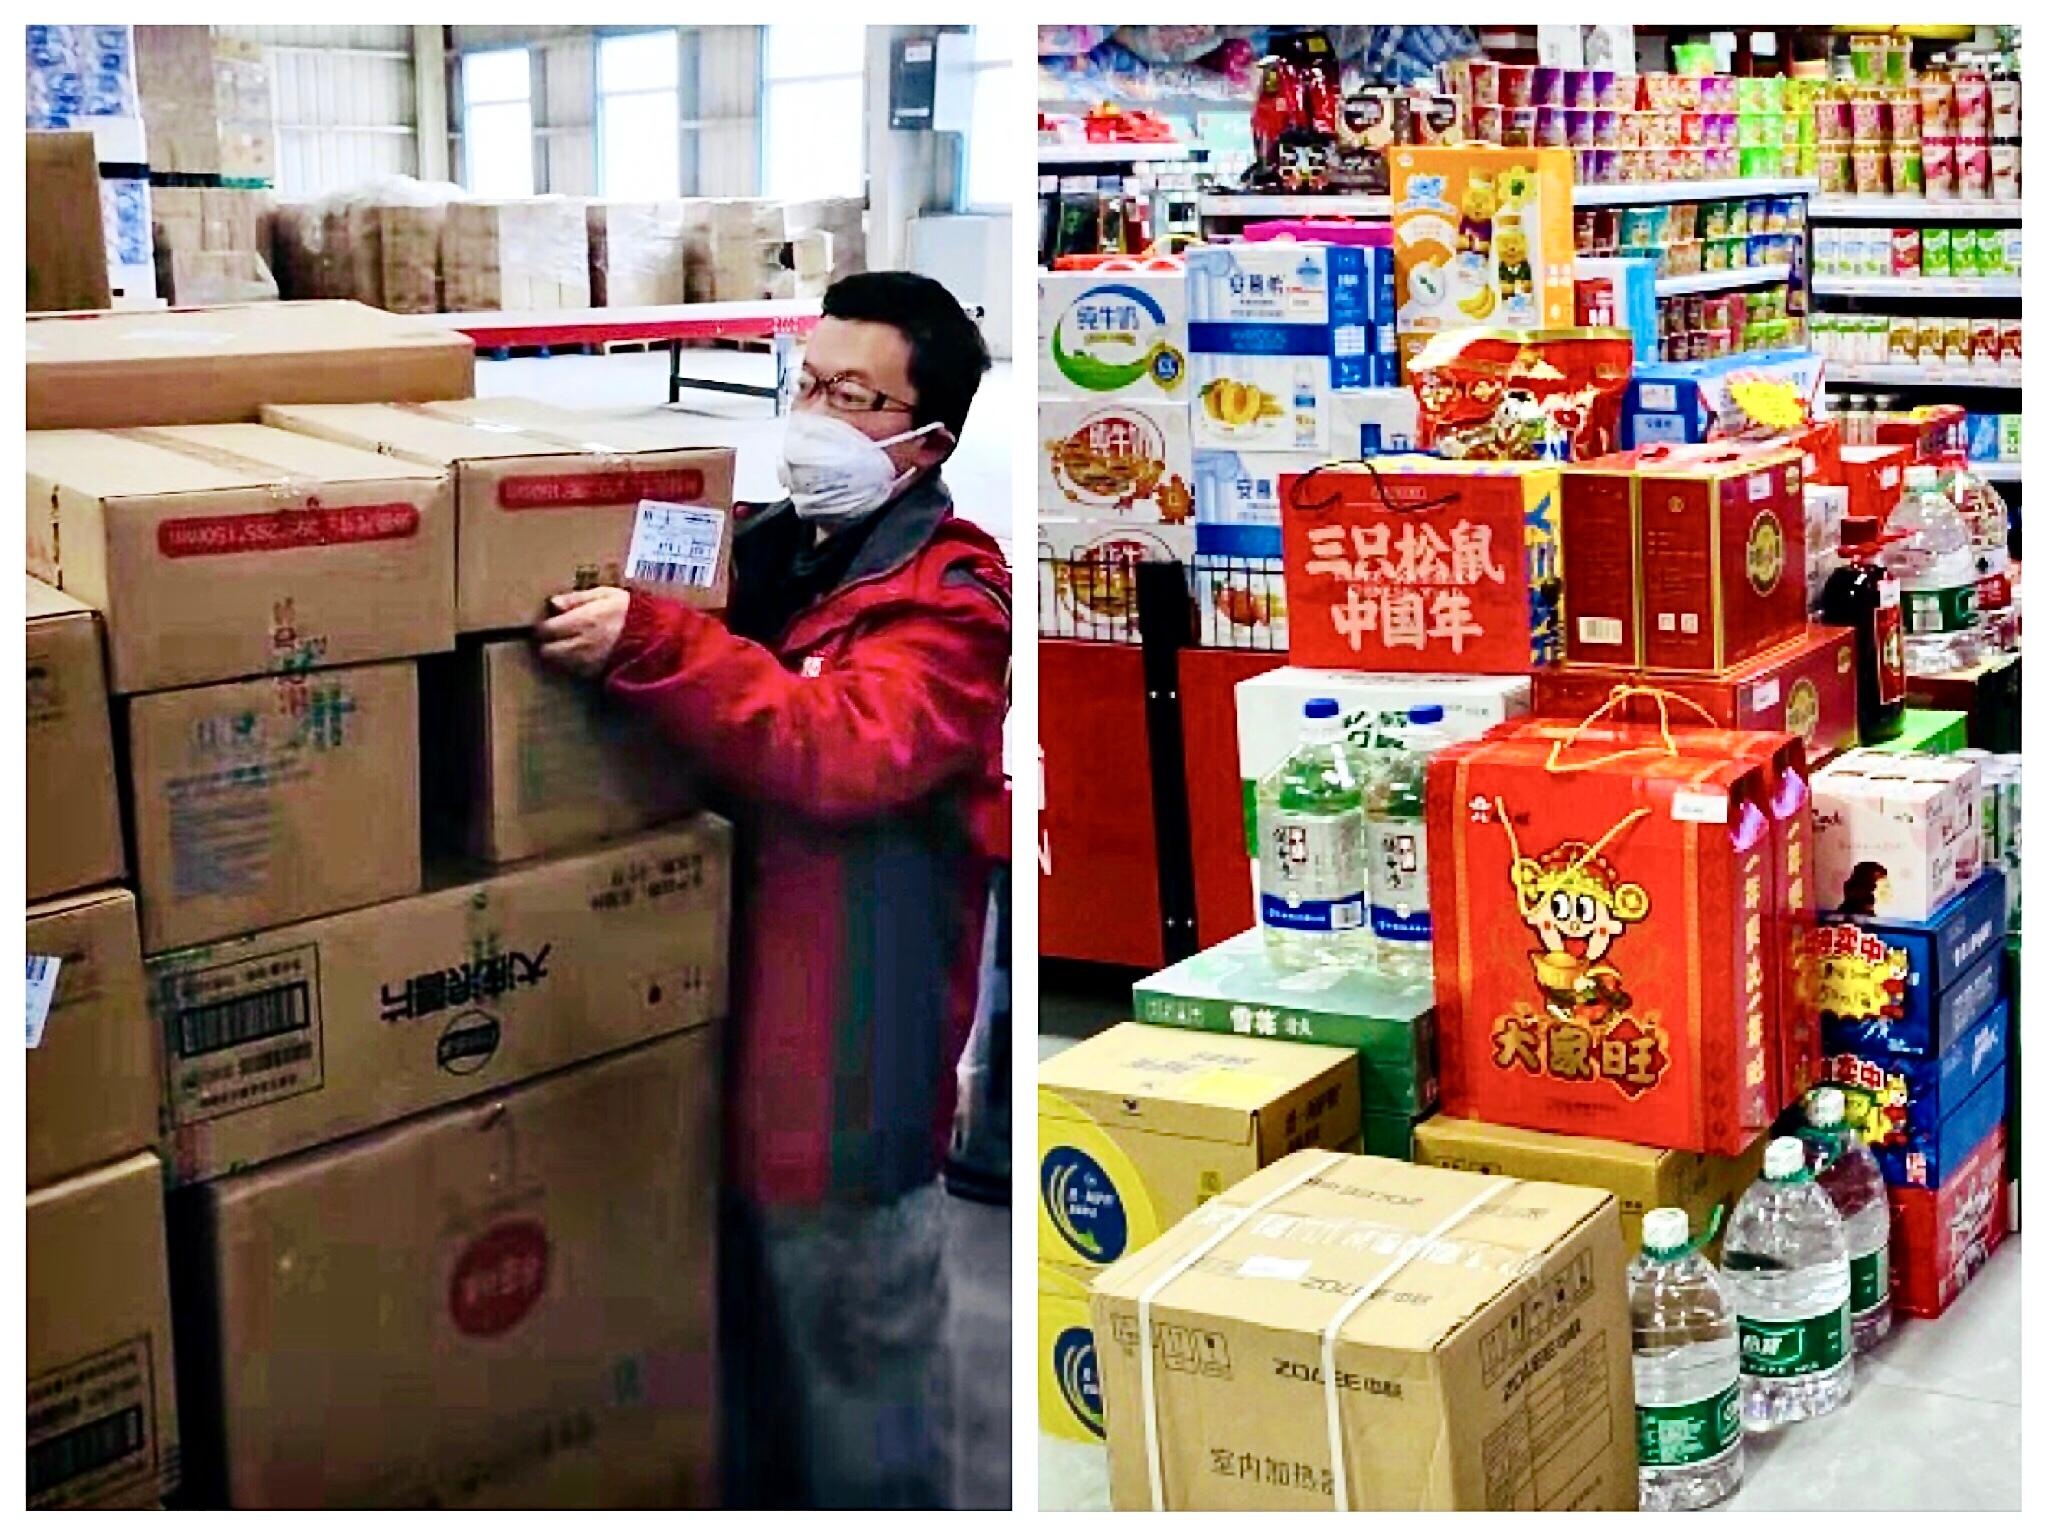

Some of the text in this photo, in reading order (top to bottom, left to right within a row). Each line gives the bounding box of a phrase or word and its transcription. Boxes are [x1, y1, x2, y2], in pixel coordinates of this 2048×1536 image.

[1305, 518, 1505, 586] 三只松鼠
[1330, 586, 1485, 656] 中国年
[1495, 1020, 1658, 1084] 大家旺
